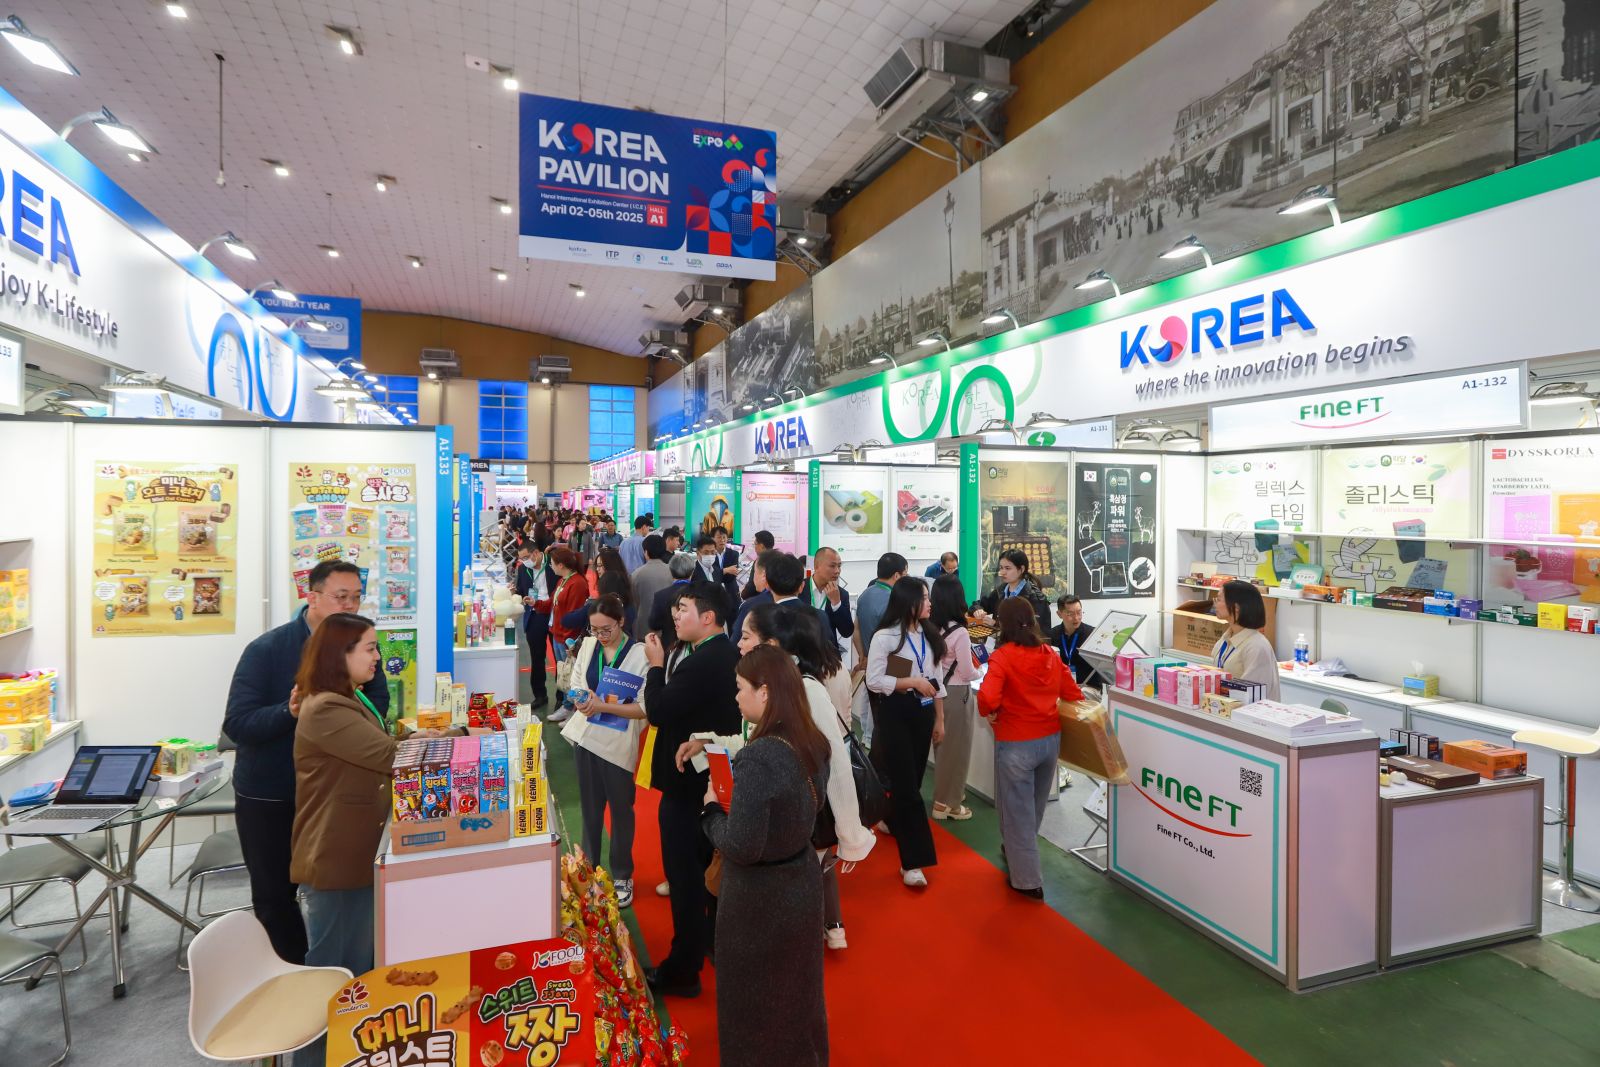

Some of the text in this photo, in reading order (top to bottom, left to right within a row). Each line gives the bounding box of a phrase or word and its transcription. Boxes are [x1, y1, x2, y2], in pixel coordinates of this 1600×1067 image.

[539, 119, 668, 164] KOREA
[693, 134, 723, 148] EXPO
[539, 156, 669, 196] PAVILION
[541, 202, 644, 223] April 02-05th 2025
[557, 195, 588, 203] International
[588, 198, 612, 207] Exhibition
[613, 201, 629, 209] Center
[0, 168, 81, 277] EA
[650, 214, 664, 224] A1
[605, 250, 619, 259] ITP
[37, 279, 118, 338] K-Lifestyle
[261, 298, 279, 307] YOU
[307, 301, 330, 311] YEAR
[1121, 288, 1316, 369] KOREA
[1135, 334, 1408, 395] where the innovation begins
[1461, 376, 1508, 390] A1-132
[755, 416, 810, 455] KOREA
[438, 437, 450, 475] A1-133
[1507, 446, 1594, 458] DYSSKOREA
[460, 460, 469, 485] A1-134
[968, 452, 977, 485] A1-132
[161, 477, 186, 487] 미니
[1254, 480, 1305, 498] 릴렉스
[1345, 484, 1435, 505] 졸리스틱
[1270, 502, 1304, 521] 타임
[602, 677, 639, 690] CATALOGUE
[1156, 824, 1215, 859] Fine FT Co., Ltd.
[547, 980, 573, 989] Sweet
[480, 978, 538, 1020] 스위트
[356, 997, 431, 1052] 허니
[506, 1005, 578, 1067] 짱
